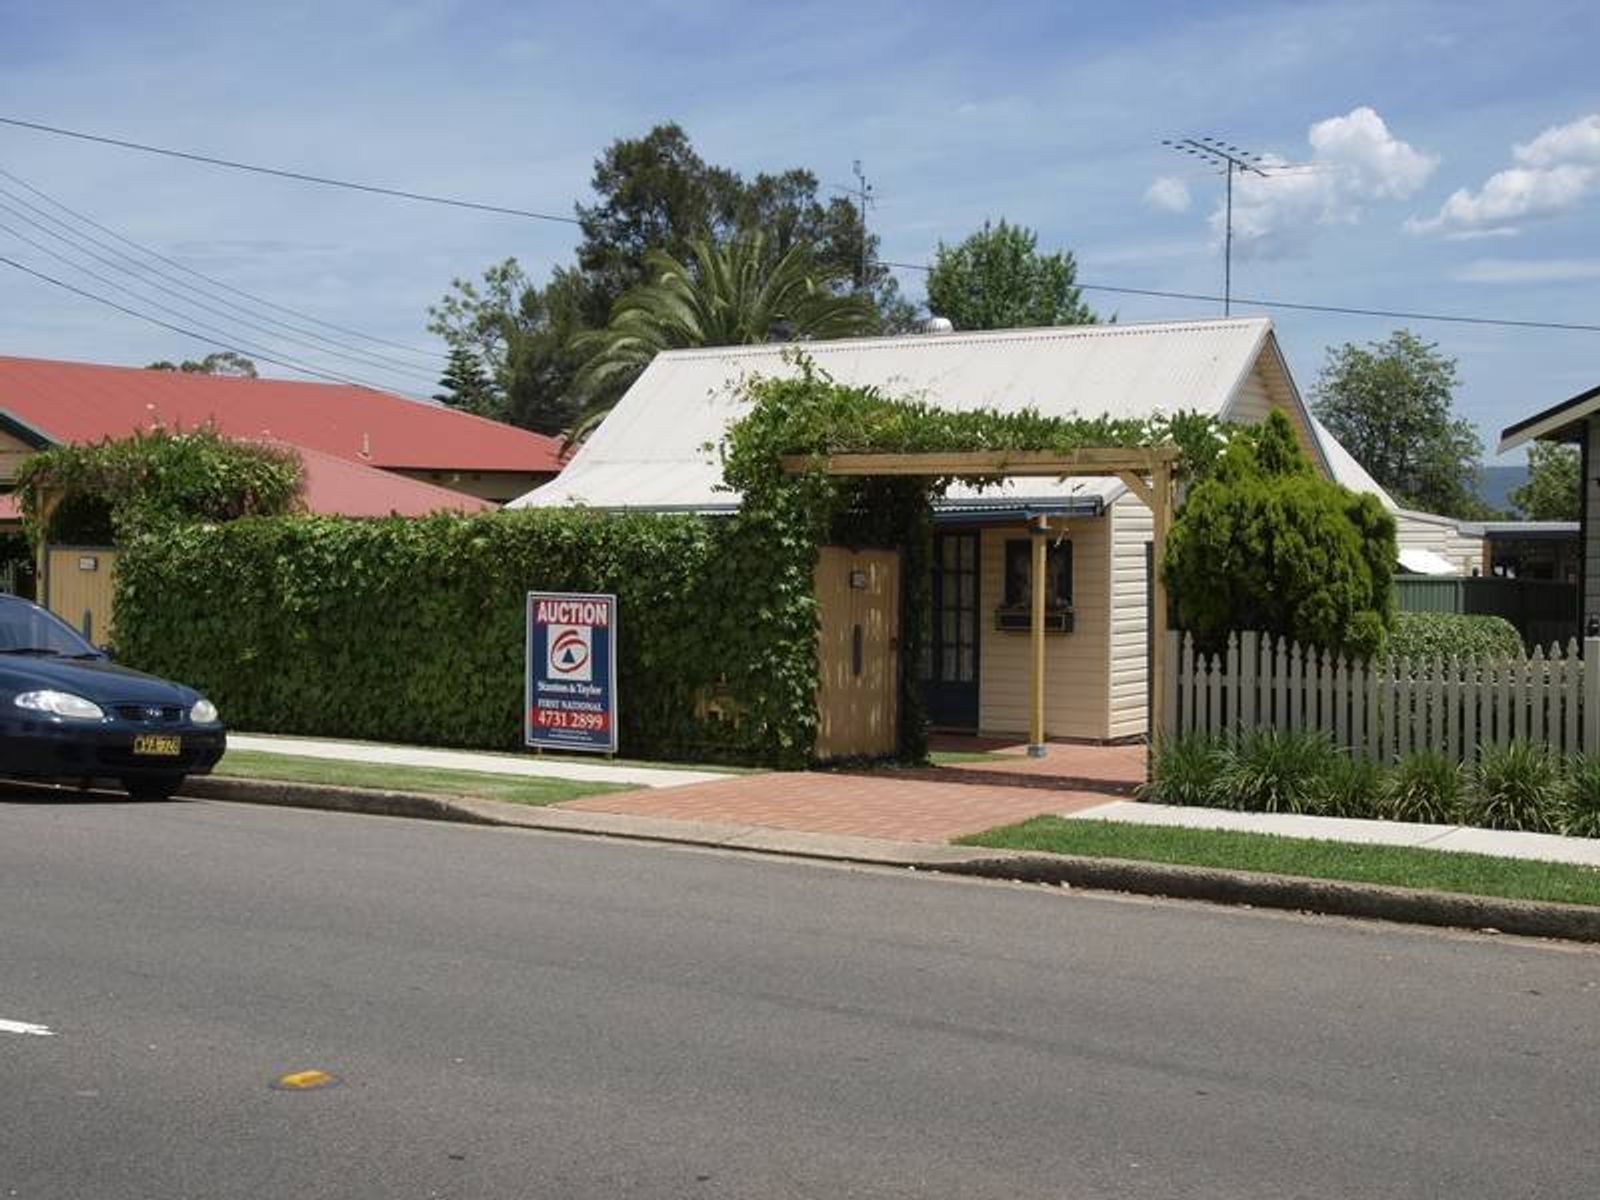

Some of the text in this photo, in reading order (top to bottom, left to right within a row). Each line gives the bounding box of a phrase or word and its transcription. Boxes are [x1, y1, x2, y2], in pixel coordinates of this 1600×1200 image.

[537, 601, 608, 625] AUCTION
[577, 683, 602, 697] Taylor
[538, 698, 603, 711] FIRST NATIONAL
[538, 710, 604, 729] 4731 2899
